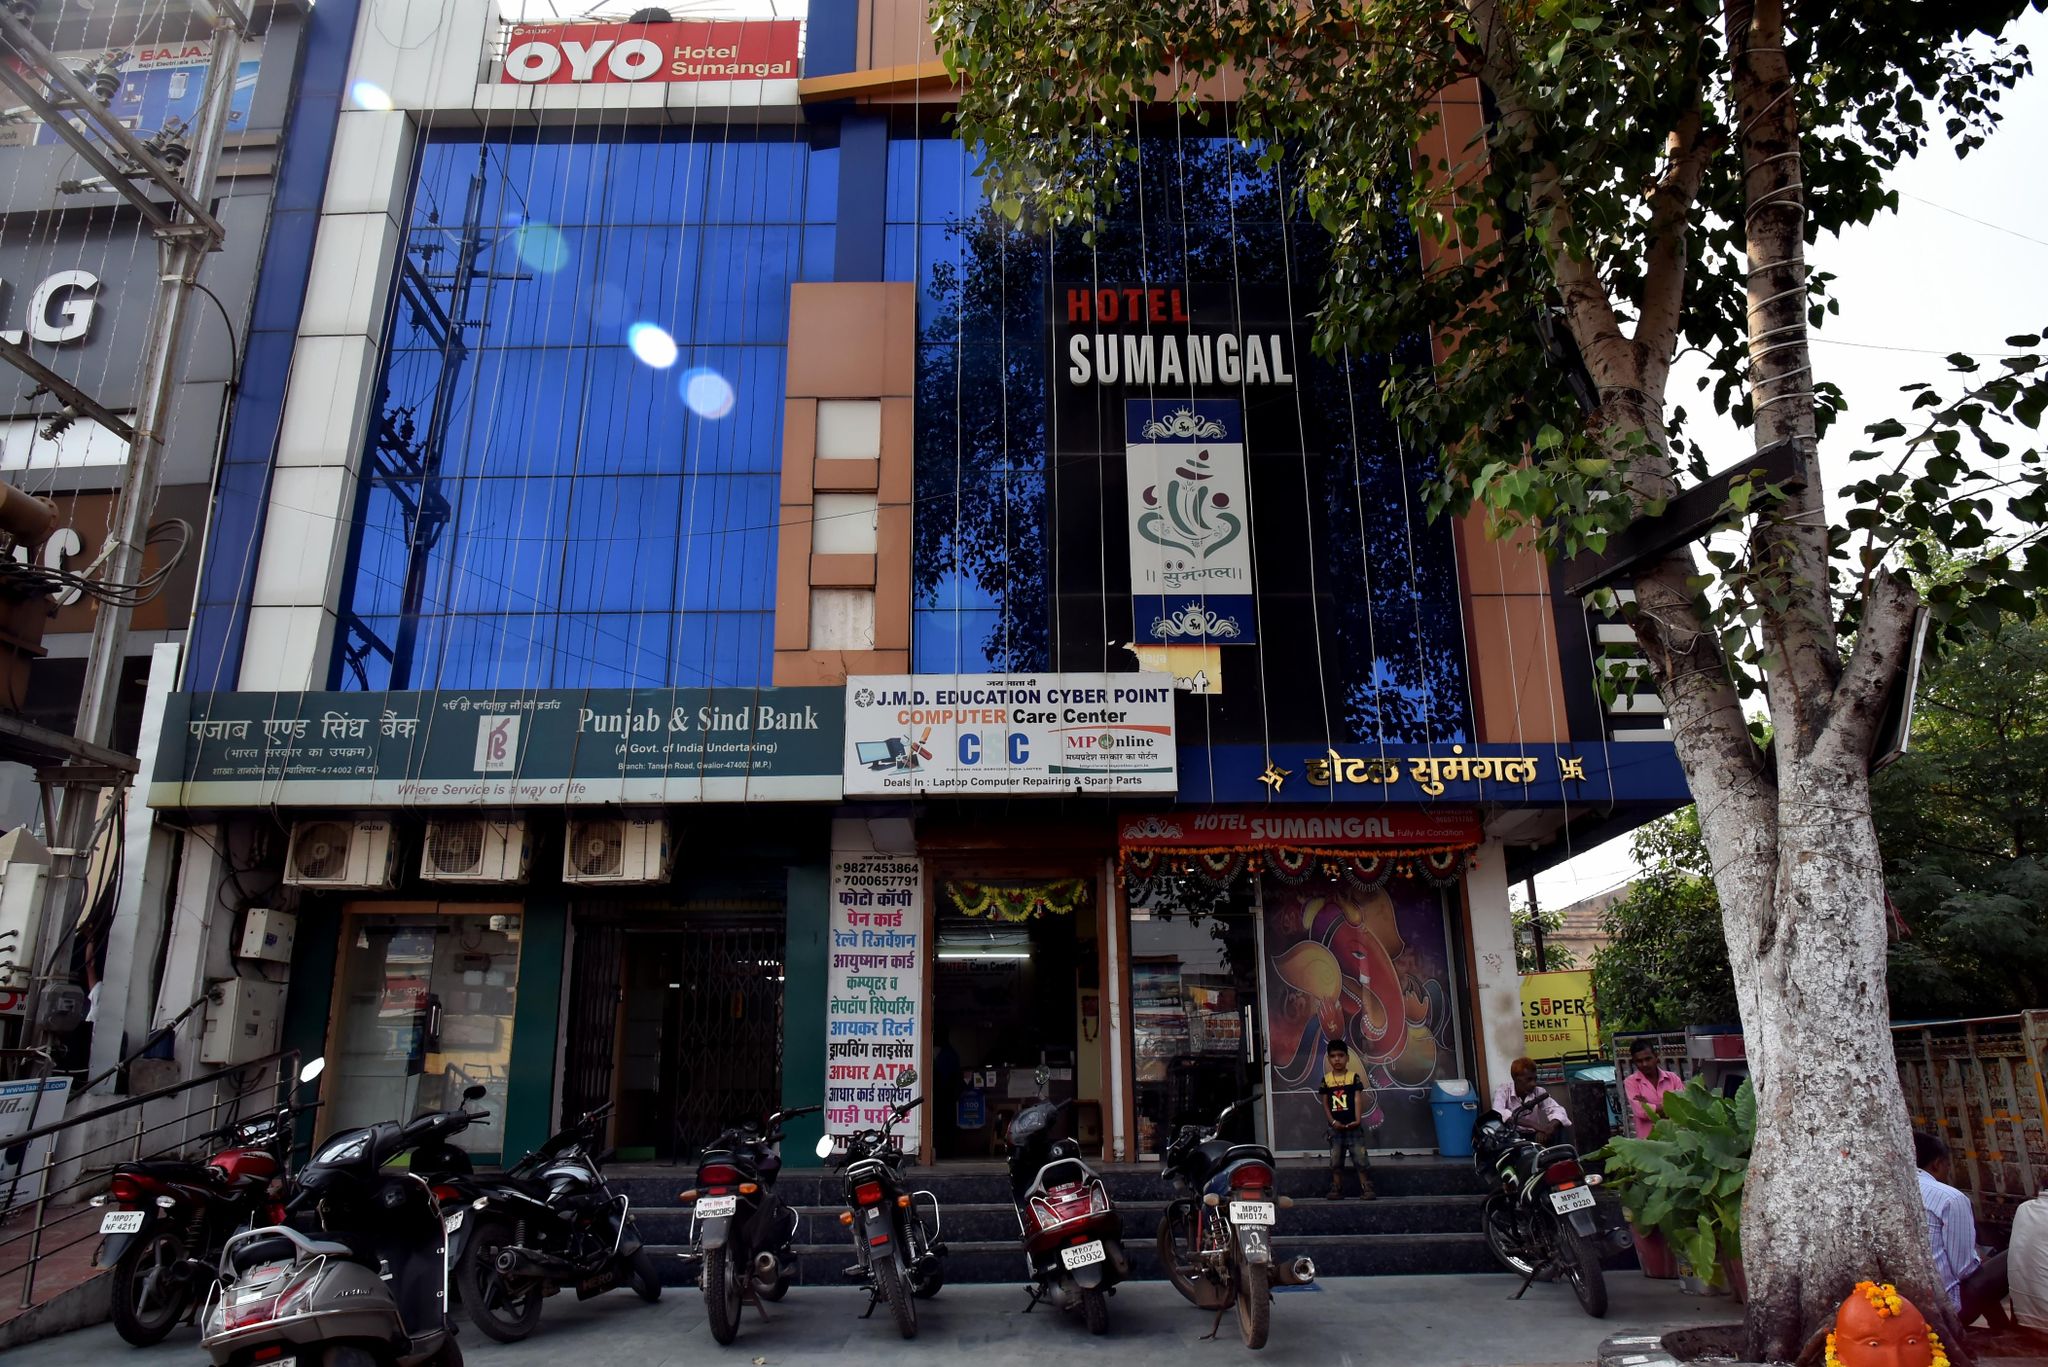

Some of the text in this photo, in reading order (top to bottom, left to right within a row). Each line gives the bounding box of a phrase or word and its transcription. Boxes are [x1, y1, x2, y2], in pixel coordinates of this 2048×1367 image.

[140, 46, 212, 61] BAJA
[506, 38, 663, 82] OYO
[674, 46, 737, 59] Hotel
[672, 61, 791, 76] Sumangal
[1067, 289, 1191, 323] HOTEL
[1069, 333, 1293, 386] SUMANGAL
[877, 691, 930, 706] J.M.D.
[936, 689, 1041, 705] EDUCATION
[1048, 688, 1107, 704] CYBER
[1114, 688, 1169, 703] POINT
[577, 705, 819, 738] Punjab & Sind Bank
[897, 708, 1127, 725] COMPUTER Care Center
[188, 710, 420, 745] पंजाब एण्ड सिंध बैंक
[308, 748, 322, 757] का
[615, 742, 778, 755] (A Govt. of India Undertaking)
[1303, 744, 1538, 795] होटल सुमंगल
[398, 784, 439, 795] Where
[442, 783, 490, 795] Service
[494, 783, 505, 795] is
[520, 785, 546, 797] way
[550, 782, 564, 794] of
[884, 777, 912, 787] Deals
[915, 777, 924, 786] In
[933, 777, 967, 789] Laptop
[970, 776, 1020, 788] Computer
[1023, 775, 1071, 788] Repairing
[1074, 776, 1081, 785] &
[1084, 776, 1113, 787] Spare
[1116, 775, 1143, 785] Parts
[1194, 814, 1248, 830] HOTEL
[1250, 817, 1395, 839] SUMANGAL
[843, 863, 919, 873] 9827453864
[844, 875, 918, 886] 7000657791
[839, 888, 913, 907] फोटो कॉपी
[847, 908, 903, 927] पेन कार्ड
[890, 950, 915, 969] कार्ड
[1530, 998, 1585, 1016] SUPER
[830, 1021, 879, 1036] आयकर
[1523, 1018, 1569, 1030] CEMENT
[1524, 1032, 1571, 1043] BUILD SAFE
[829, 1065, 870, 1080] आधार
[828, 1087, 855, 1102] आधार
[1332, 1094, 1349, 1112] N
[1561, 1192, 1580, 1201] MP07
[1572, 1199, 1591, 1208] 0220
[1067, 1251, 1103, 1266] SG9932
